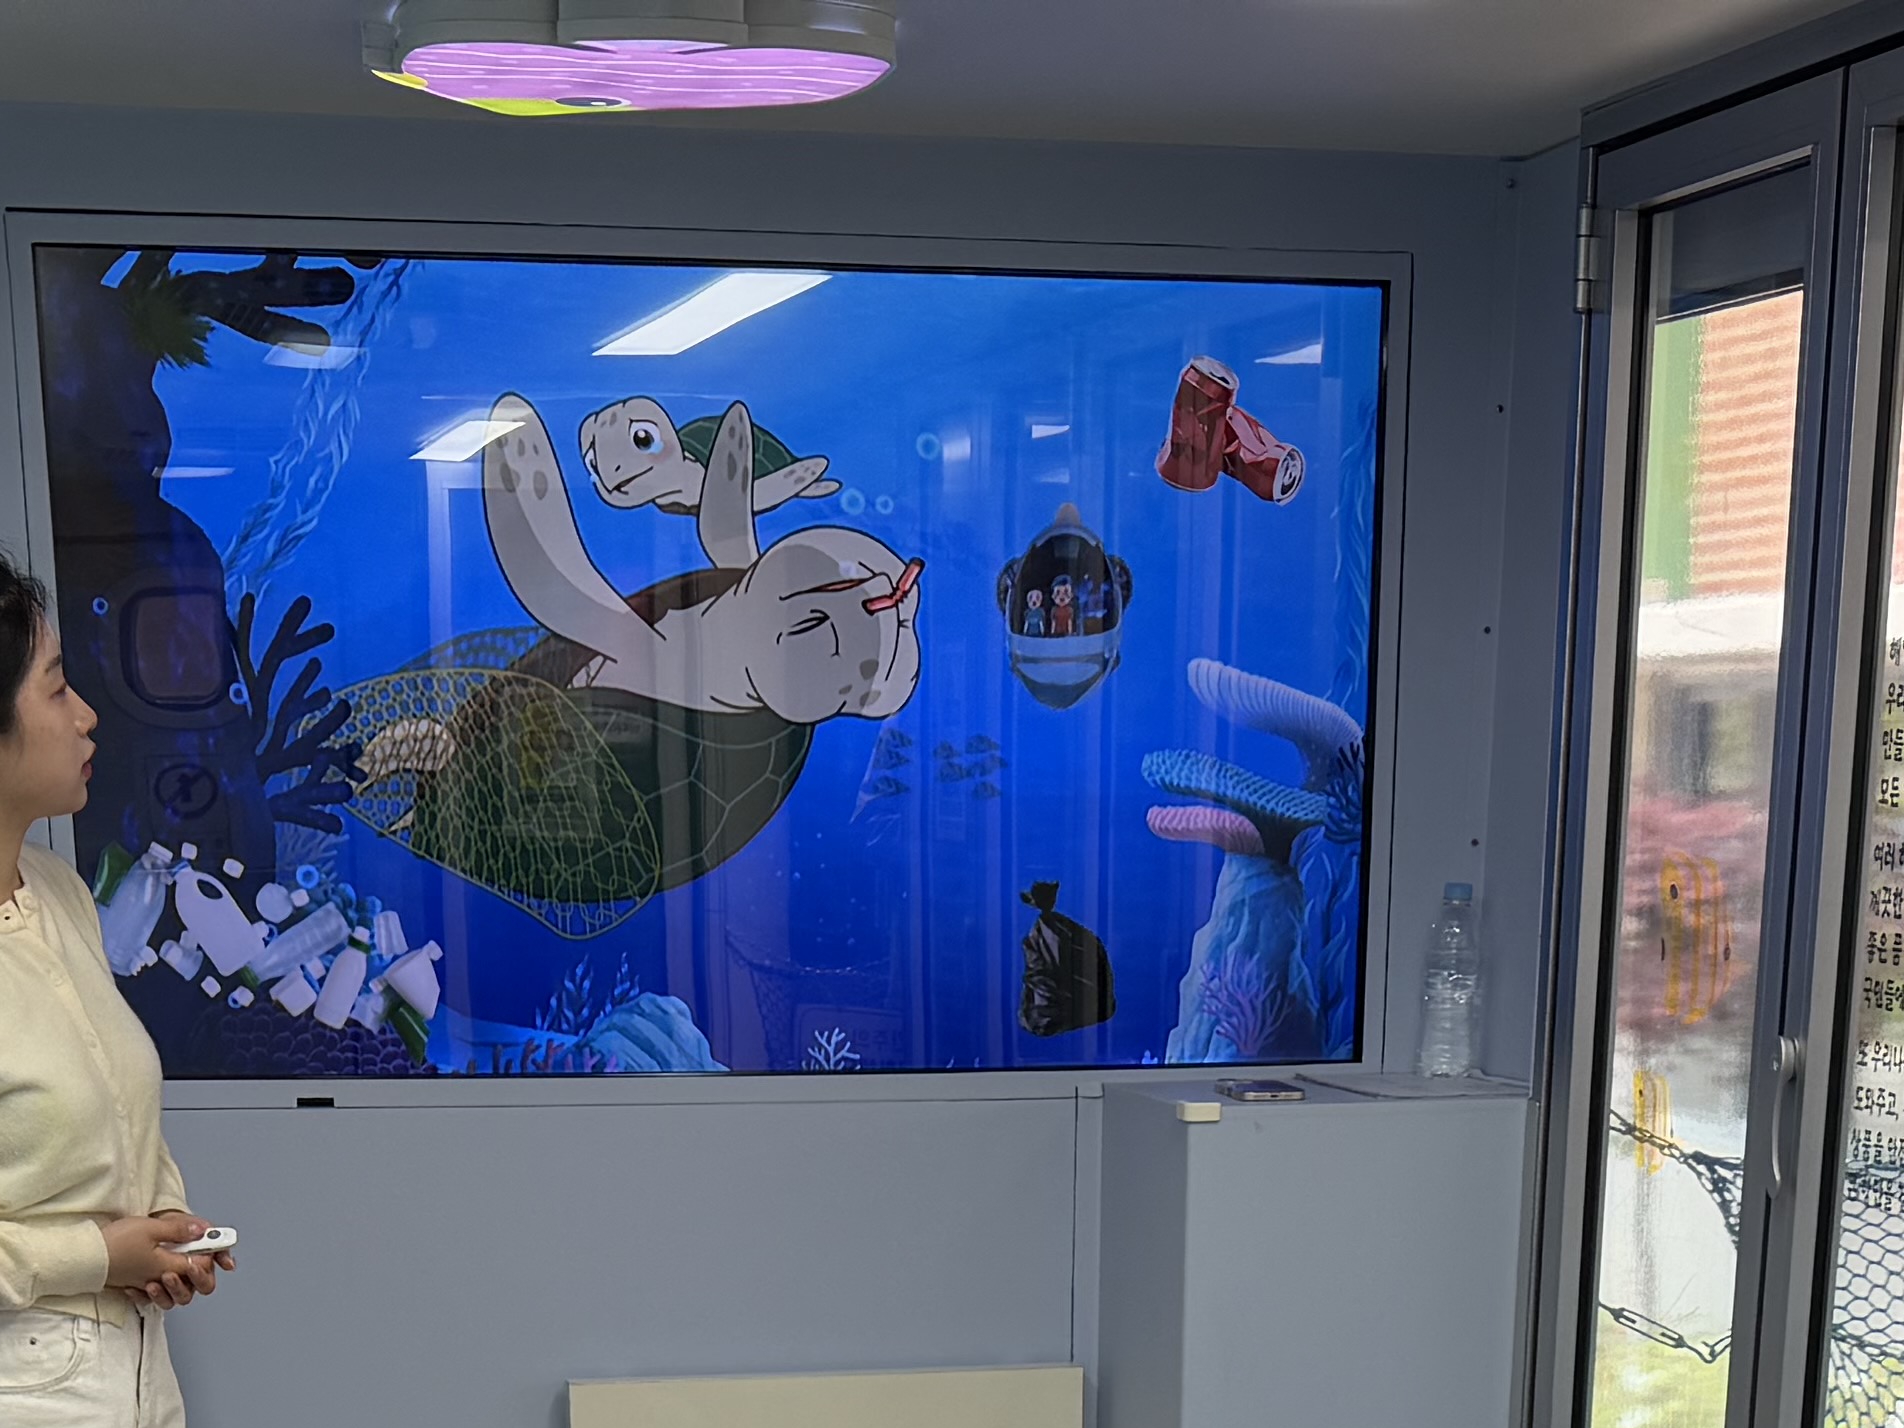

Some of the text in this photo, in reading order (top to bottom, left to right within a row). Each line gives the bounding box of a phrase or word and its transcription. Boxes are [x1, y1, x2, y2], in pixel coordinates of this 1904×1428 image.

[1878, 776, 1900, 808] 모든
[1874, 842, 1895, 872] 여러
[1867, 931, 1887, 964] 좋은
[1854, 1086, 1898, 1121] 도와주고,
